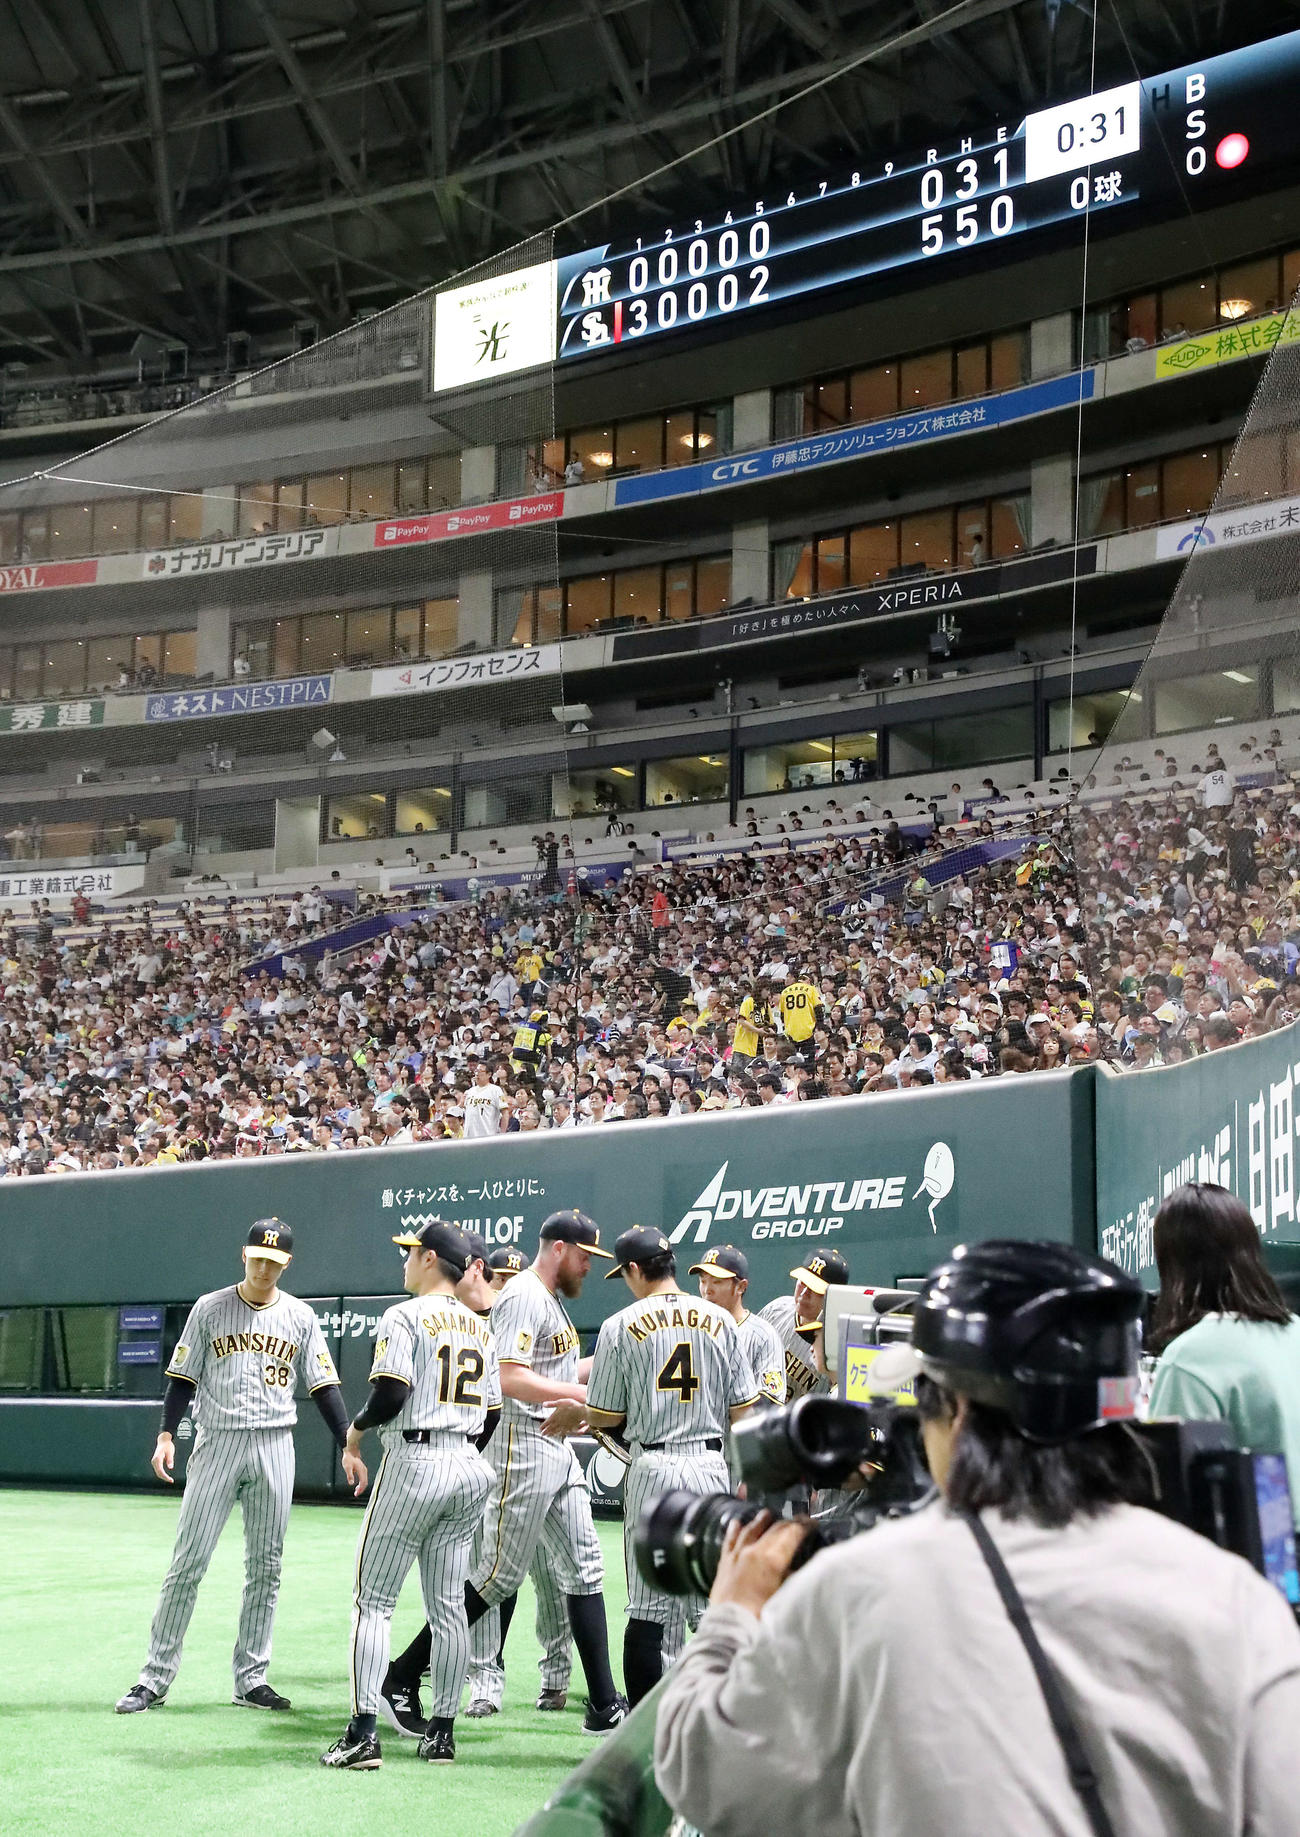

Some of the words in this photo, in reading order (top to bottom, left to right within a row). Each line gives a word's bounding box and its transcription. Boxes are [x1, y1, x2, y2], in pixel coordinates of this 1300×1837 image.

[1186, 73, 1206, 104] B
[1057, 105, 1126, 153] 0:31
[1186, 109, 1206, 139] S
[636, 238, 642, 251] 1
[665, 229, 672, 243] 2
[695, 220, 702, 234] 3
[724, 211, 733, 225] 4
[755, 201, 764, 216] 5
[787, 192, 796, 207] 6
[819, 182, 828, 196] 7
[852, 172, 860, 187] 8
[884, 162, 894, 176] 9
[927, 149, 938, 164] R
[961, 137, 972, 154] H
[997, 126, 1008, 143] E
[628, 257, 648, 294] 0
[658, 248, 678, 286] 0
[688, 239, 708, 277] 0
[718, 230, 738, 268] 0
[749, 220, 770, 260] 0
[628, 300, 648, 336] 3
[658, 292, 678, 330] 0
[688, 282, 708, 320] 0
[718, 274, 738, 312] 0
[749, 264, 770, 302] 2
[473, 321, 511, 366] 光
[1169, 347, 1205, 365] FUDO
[711, 458, 762, 481] CTC
[771, 407, 986, 469] 伊藤忠テクノソリューションズ株式会社
[460, 514, 490, 526] PayPay
[522, 502, 554, 516] PayPay
[397, 525, 430, 537] PayPay
[1223, 516, 1277, 539] 株式会社
[170, 532, 324, 574] ナガノインテリア
[0, 567, 44, 590] YAL
[878, 581, 963, 611] XPERIA
[732, 603, 861, 636] 「好き」を極めたい人々へ
[419, 650, 540, 686] インフォセンス
[172, 691, 224, 715] ネスト
[231, 680, 328, 710] NESTPIA
[786, 994, 806, 1010] 80
[382, 1178, 546, 1208] 働くチャンスを、一人ひとりに。
[668, 1160, 907, 1245] ADVENTURE
[460, 1215, 524, 1244] ILOF
[751, 1216, 844, 1240] GROUP
[315, 1311, 381, 1338] ピザクッ
[627, 1308, 724, 1343] KUMAGAI
[212, 1332, 299, 1364] HANSHIN
[264, 1364, 290, 1388] 38
[437, 1344, 484, 1407] 12
[656, 1342, 700, 1403] 4
